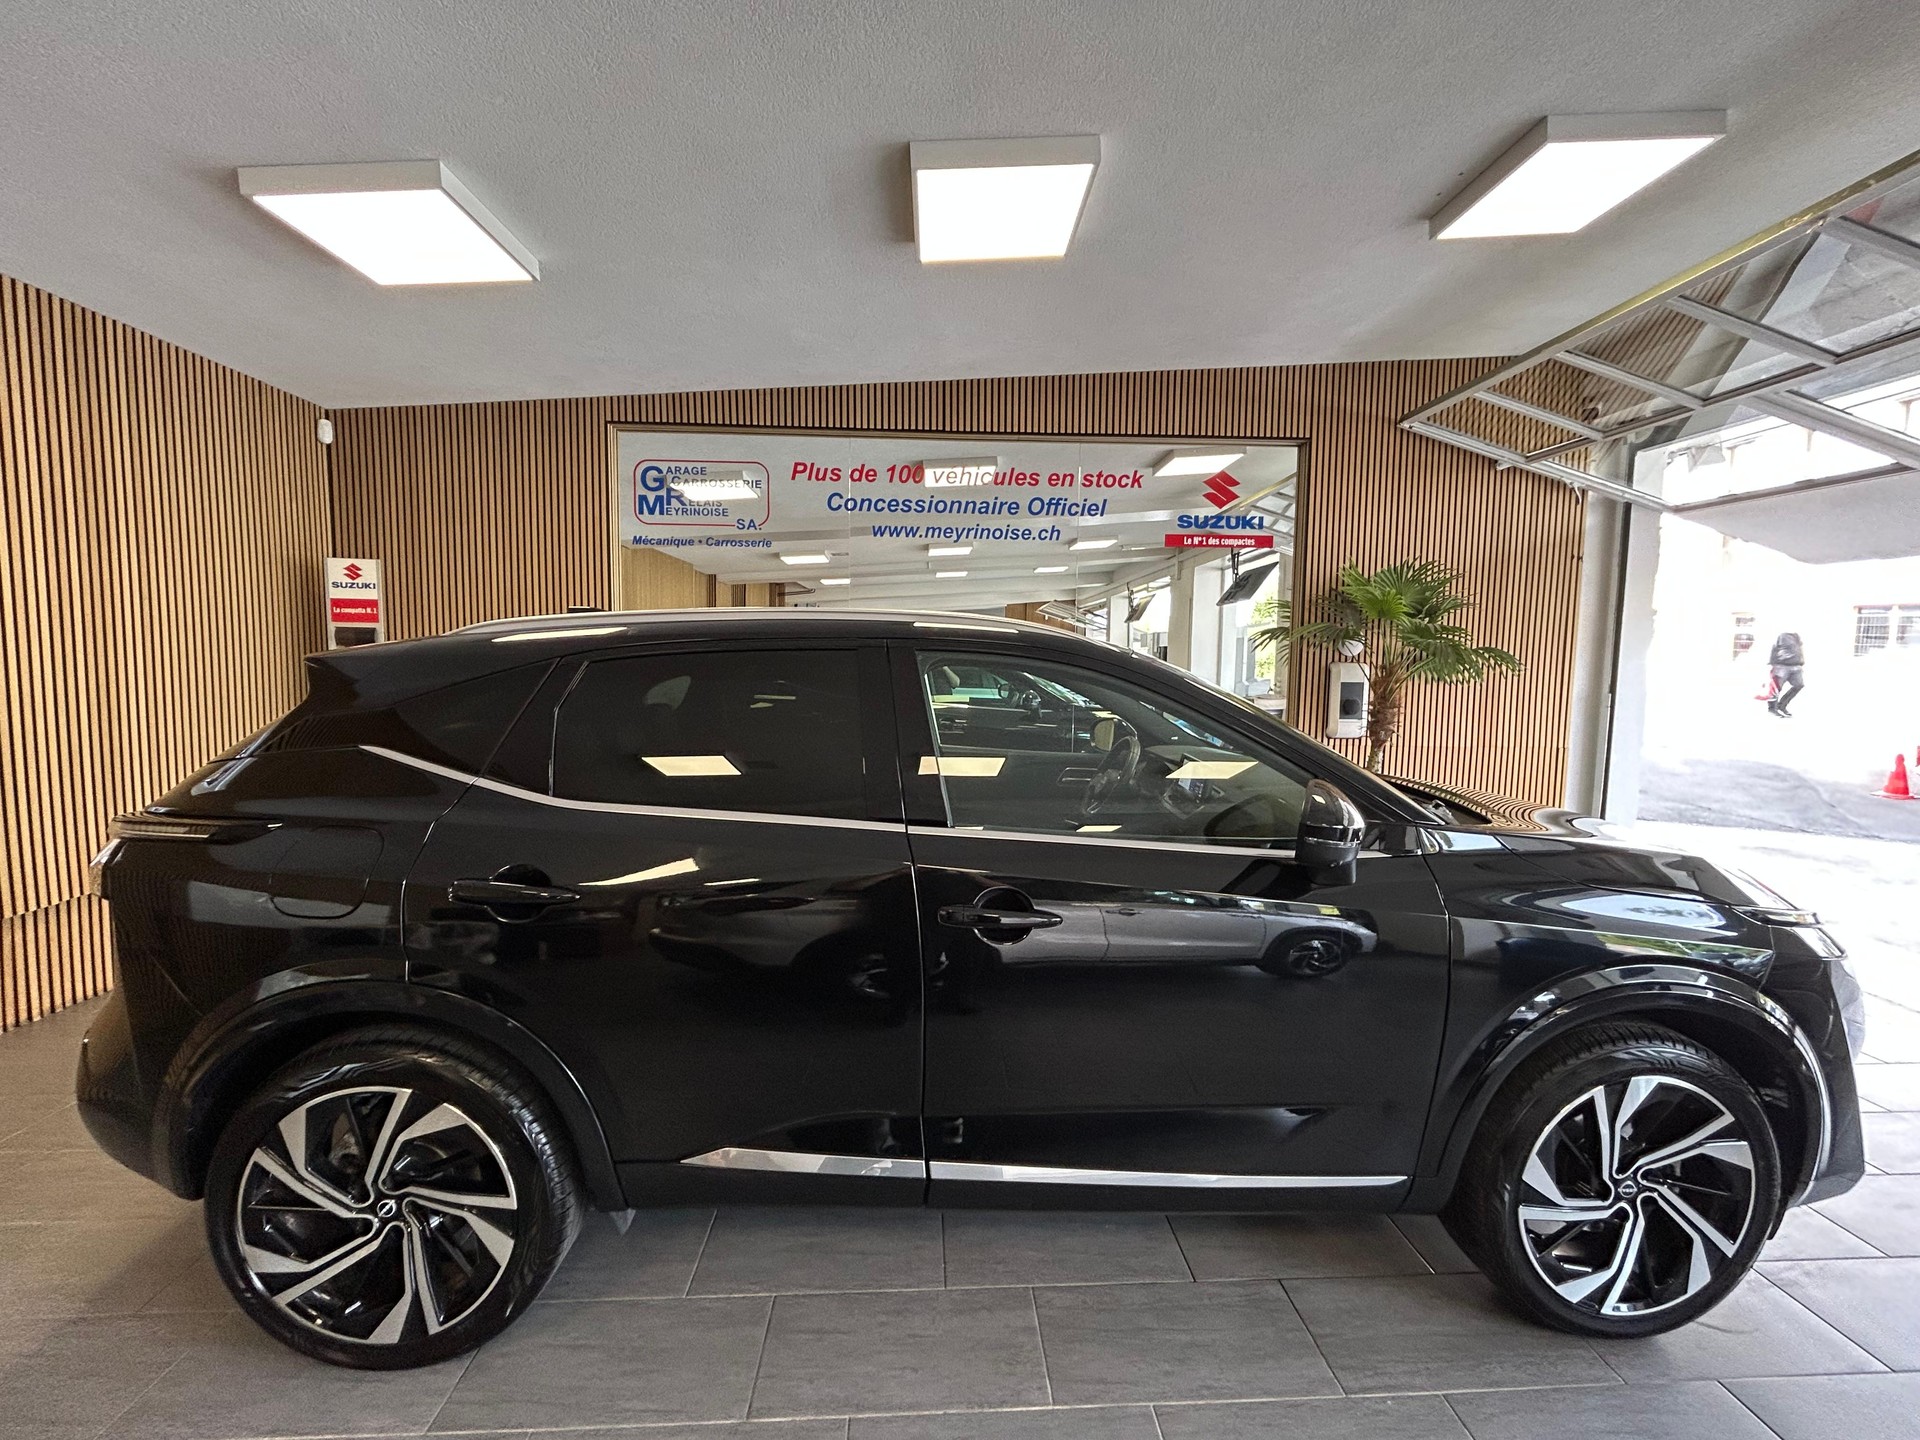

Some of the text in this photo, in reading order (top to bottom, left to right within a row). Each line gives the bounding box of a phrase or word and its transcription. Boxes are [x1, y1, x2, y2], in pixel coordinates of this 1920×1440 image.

[640, 466, 707, 492] GARAGE
[671, 476, 763, 489] CARROSSERIE
[790, 462, 1145, 489] Plus de 100 véhicules en stock
[638, 494, 729, 517] MEYRINOISE
[827, 492, 1108, 517] Concessionnaire Officiel
[1177, 514, 1264, 530] SUZUKI
[632, 535, 772, 548] Mécanique Carrosserie
[872, 524, 1061, 543] www.meyrinoise.ch
[1184, 536, 1192, 545] Le
[1208, 537, 1220, 546] des
[1221, 538, 1255, 547] compactes
[331, 581, 376, 589] SUZUKI
